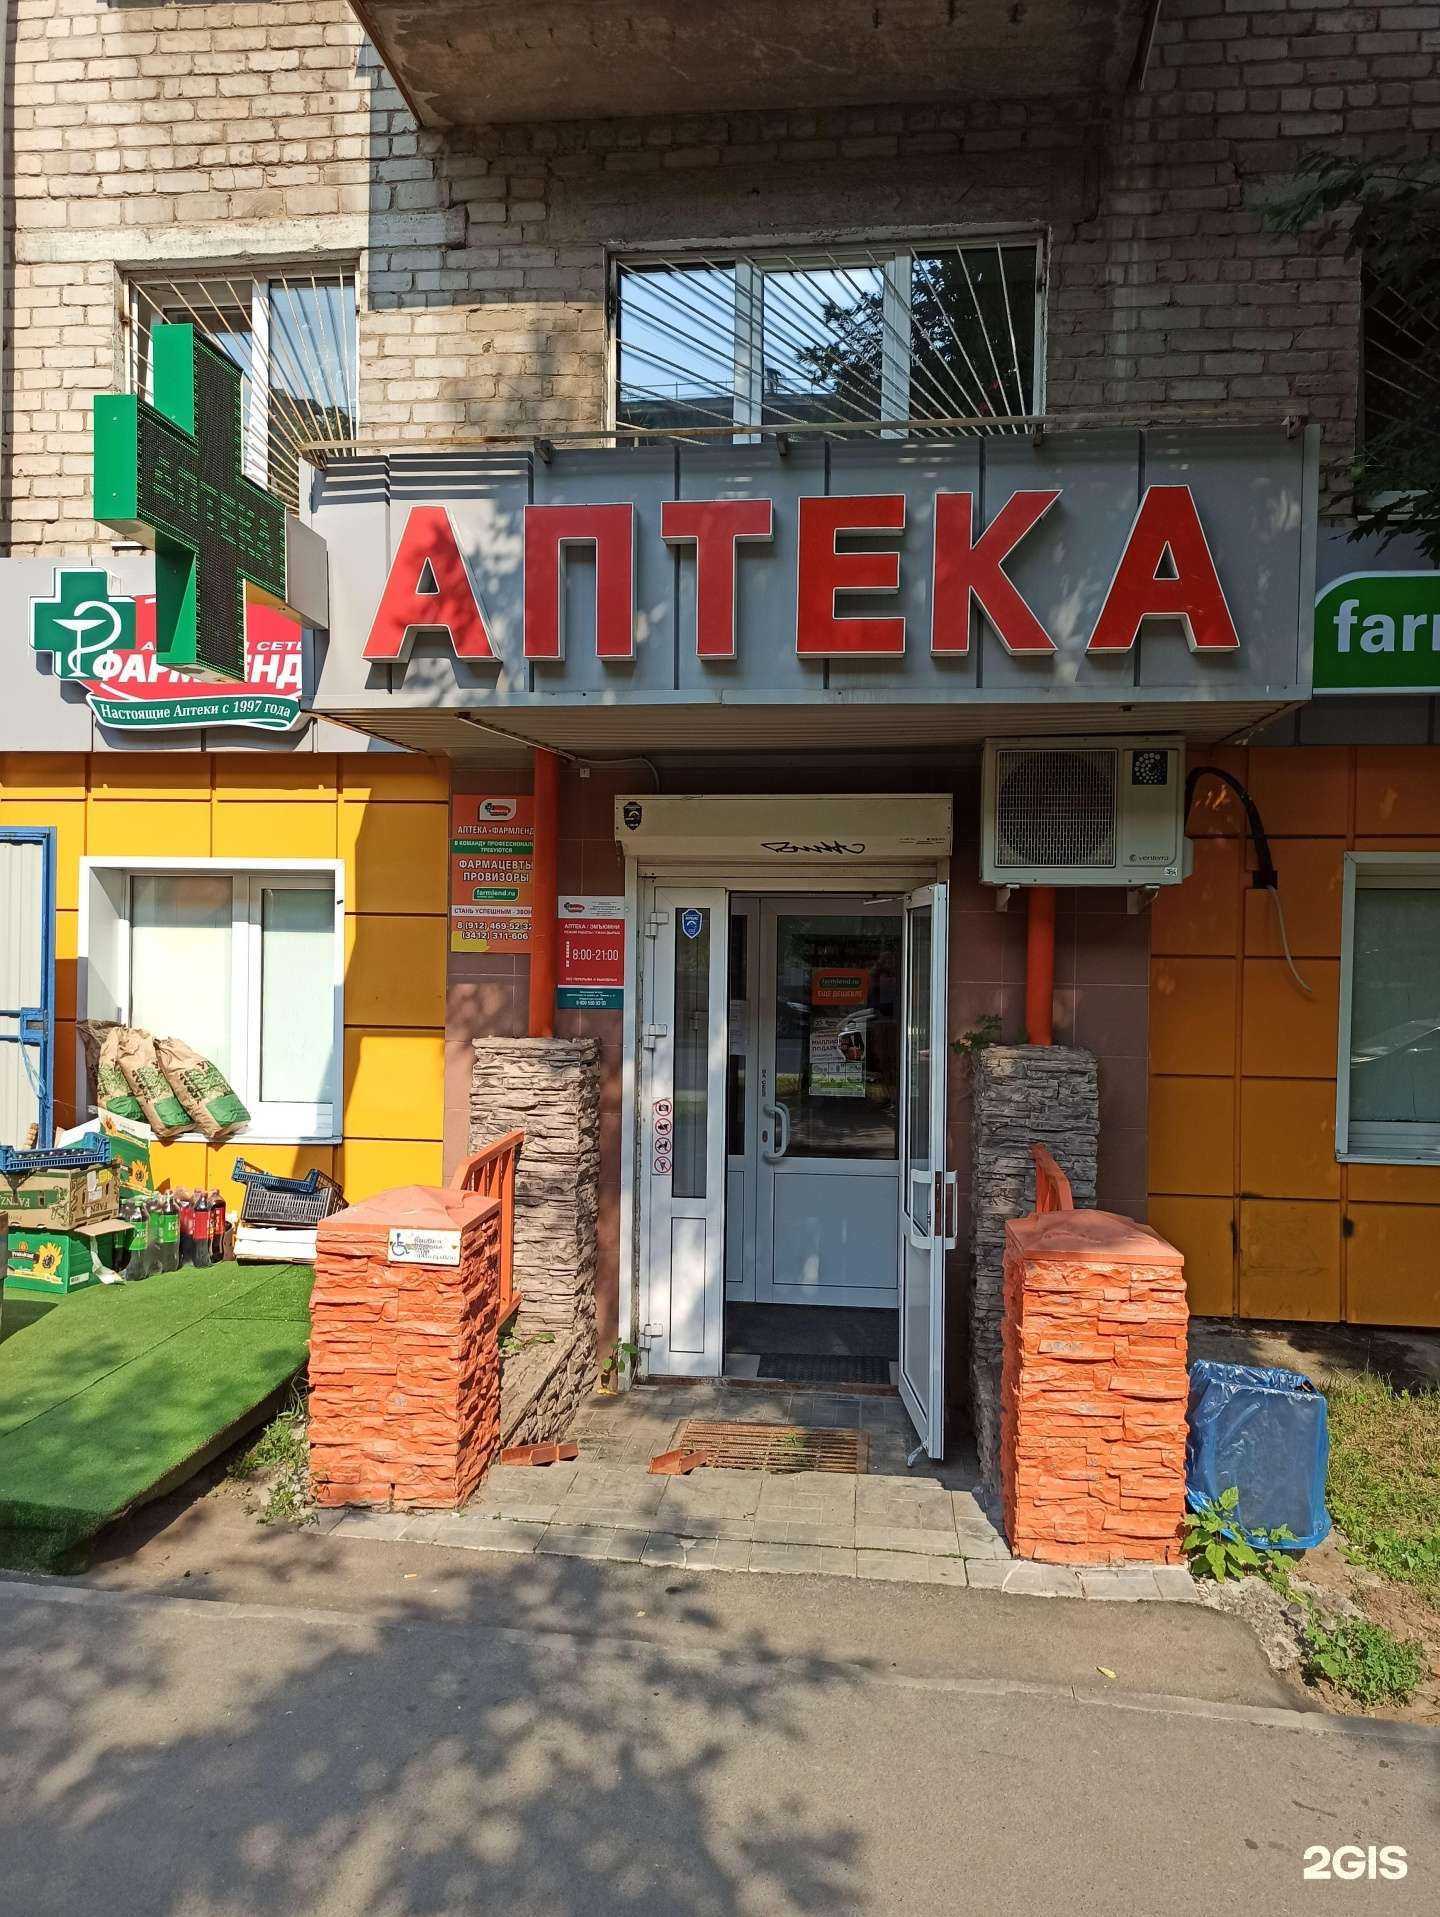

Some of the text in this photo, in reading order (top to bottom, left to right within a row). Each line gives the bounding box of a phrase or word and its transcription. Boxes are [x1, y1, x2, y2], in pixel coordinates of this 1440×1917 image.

[361, 484, 1241, 663] АПТЕКА
[1333, 599, 1440, 653] far
[92, 649, 302, 690] ФАРНД
[100, 701, 291, 720] Настоящие Аптеки с 1997 года
[463, 872, 529, 882] ПРОВИЗОРЫ
[572, 949, 619, 961] 8:00-21:00
